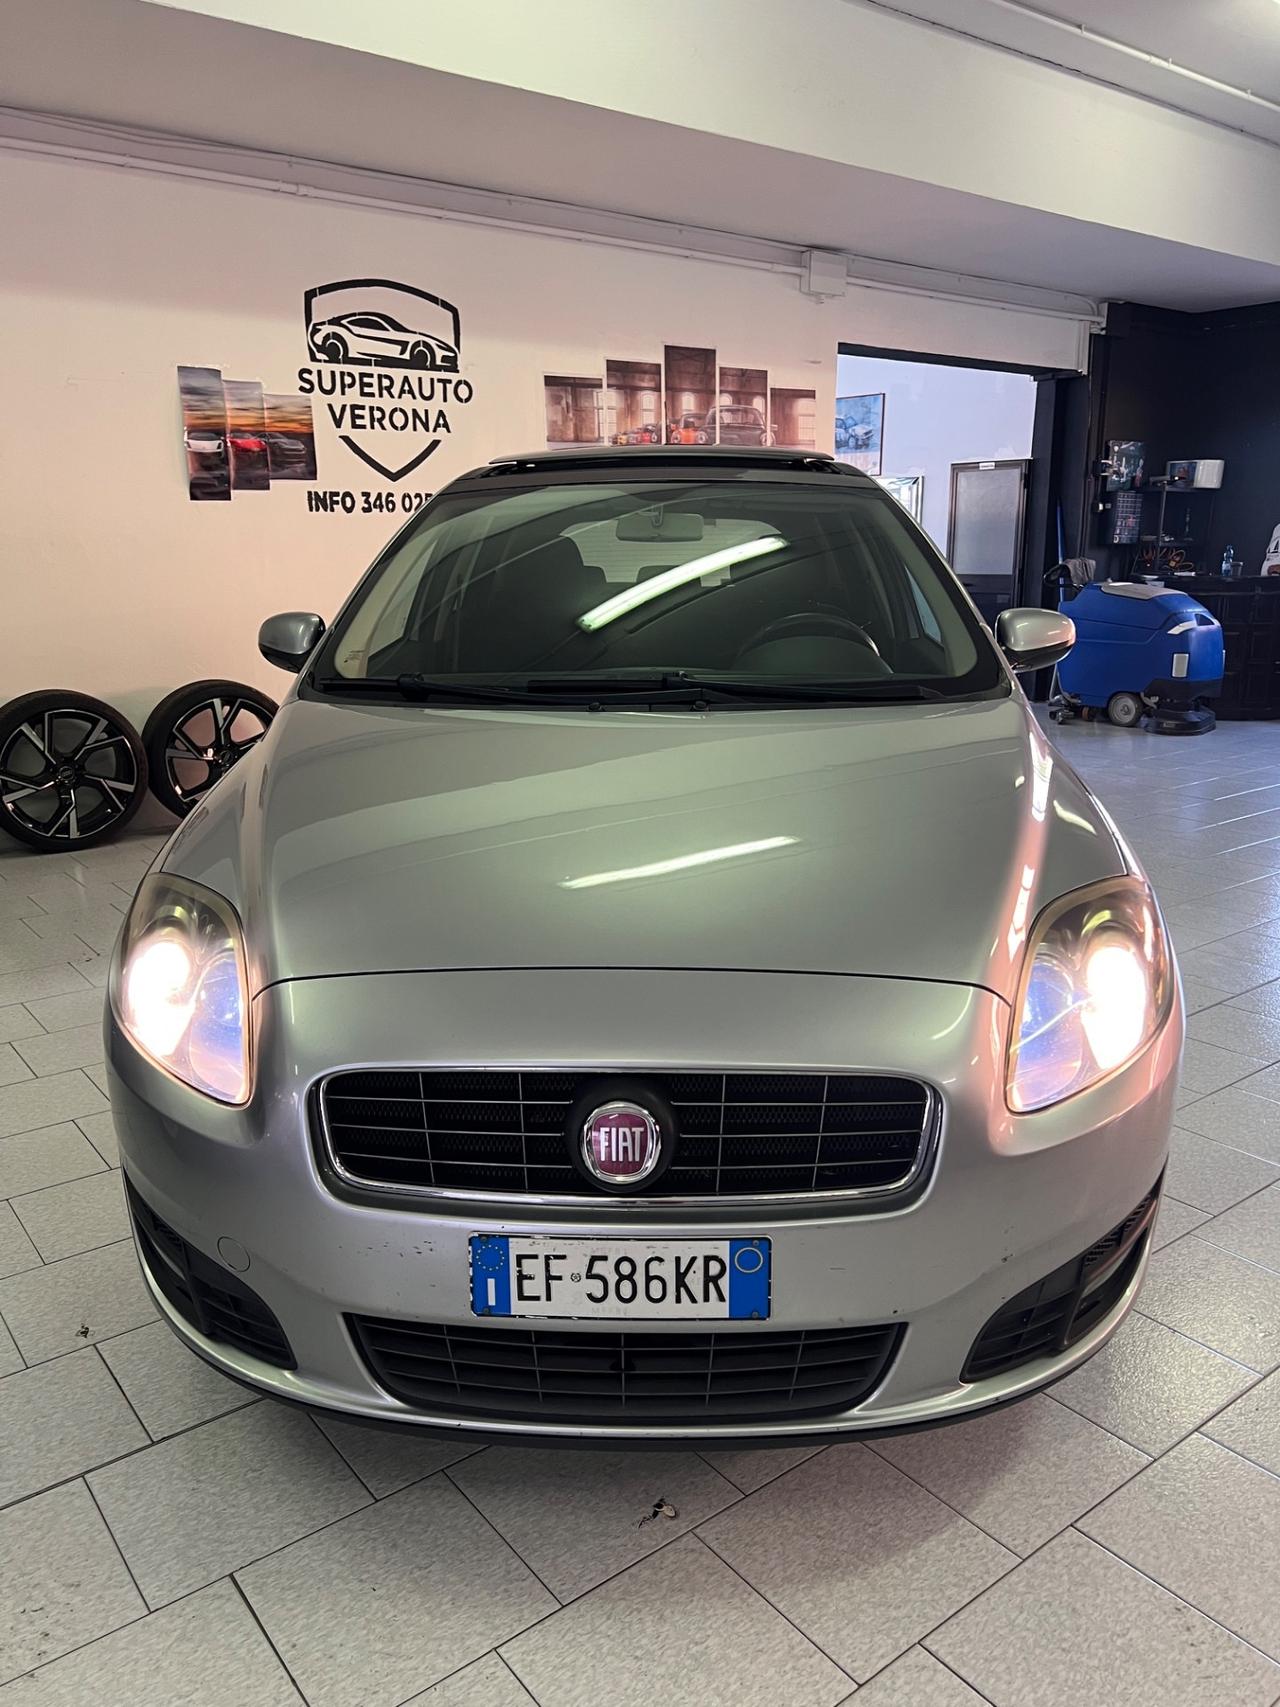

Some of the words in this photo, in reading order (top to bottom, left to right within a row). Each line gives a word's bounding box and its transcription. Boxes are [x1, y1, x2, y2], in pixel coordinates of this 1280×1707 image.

[298, 368, 473, 403] SUPERAUTO
[327, 403, 451, 433] VERONA
[307, 491, 355, 513] INFO
[361, 491, 396, 513] 346
[600, 1127, 645, 1162] FIAT
[516, 1254, 567, 1302] EF
[585, 1255, 727, 1304] 586KR
